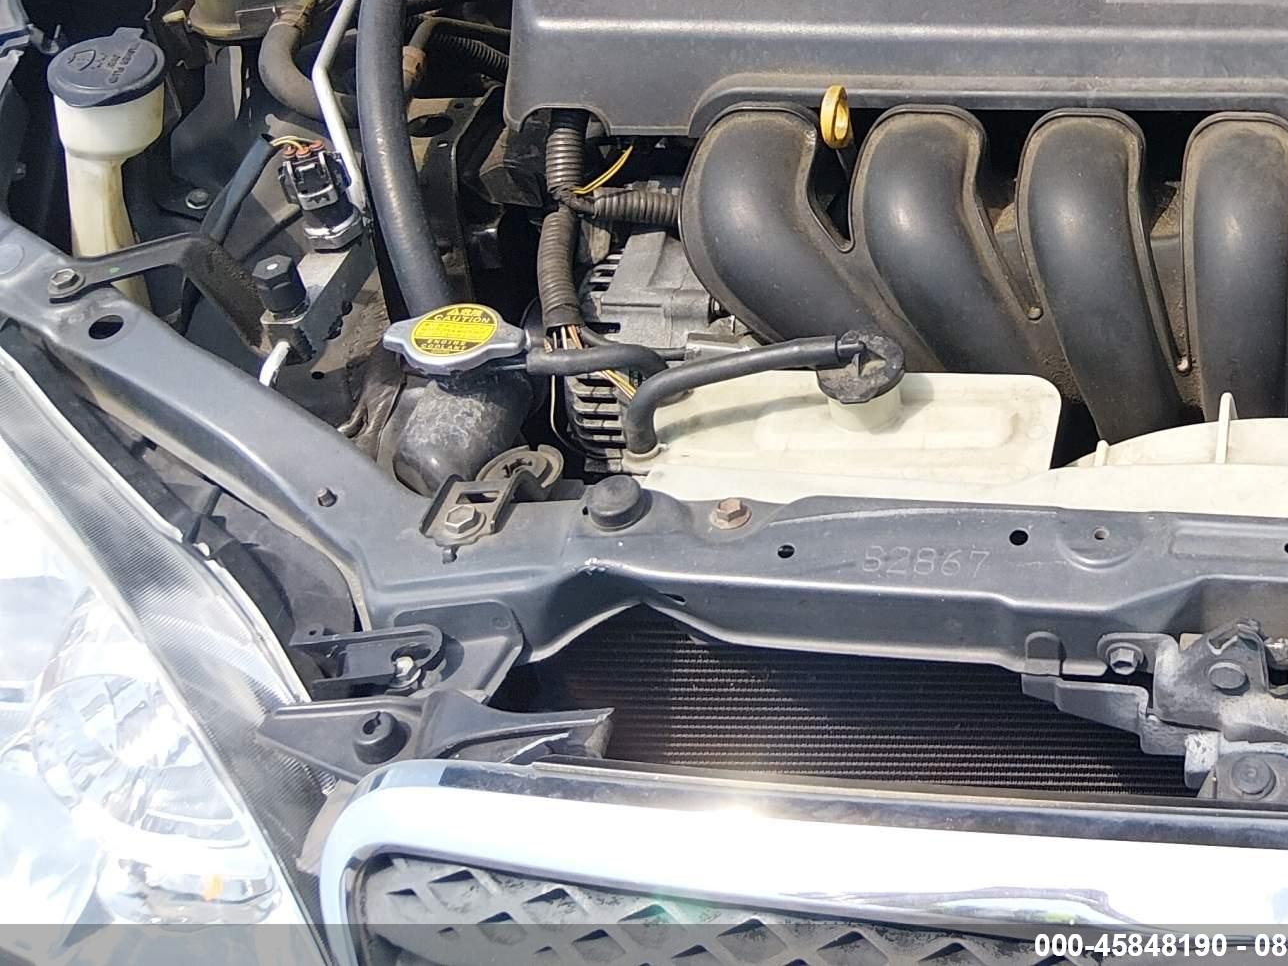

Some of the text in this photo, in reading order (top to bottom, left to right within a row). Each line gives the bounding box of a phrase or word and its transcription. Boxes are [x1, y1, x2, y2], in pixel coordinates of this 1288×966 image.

[433, 314, 491, 323] CAUTION
[426, 338, 467, 346] ENGINE
[420, 343, 467, 351] COOLANT
